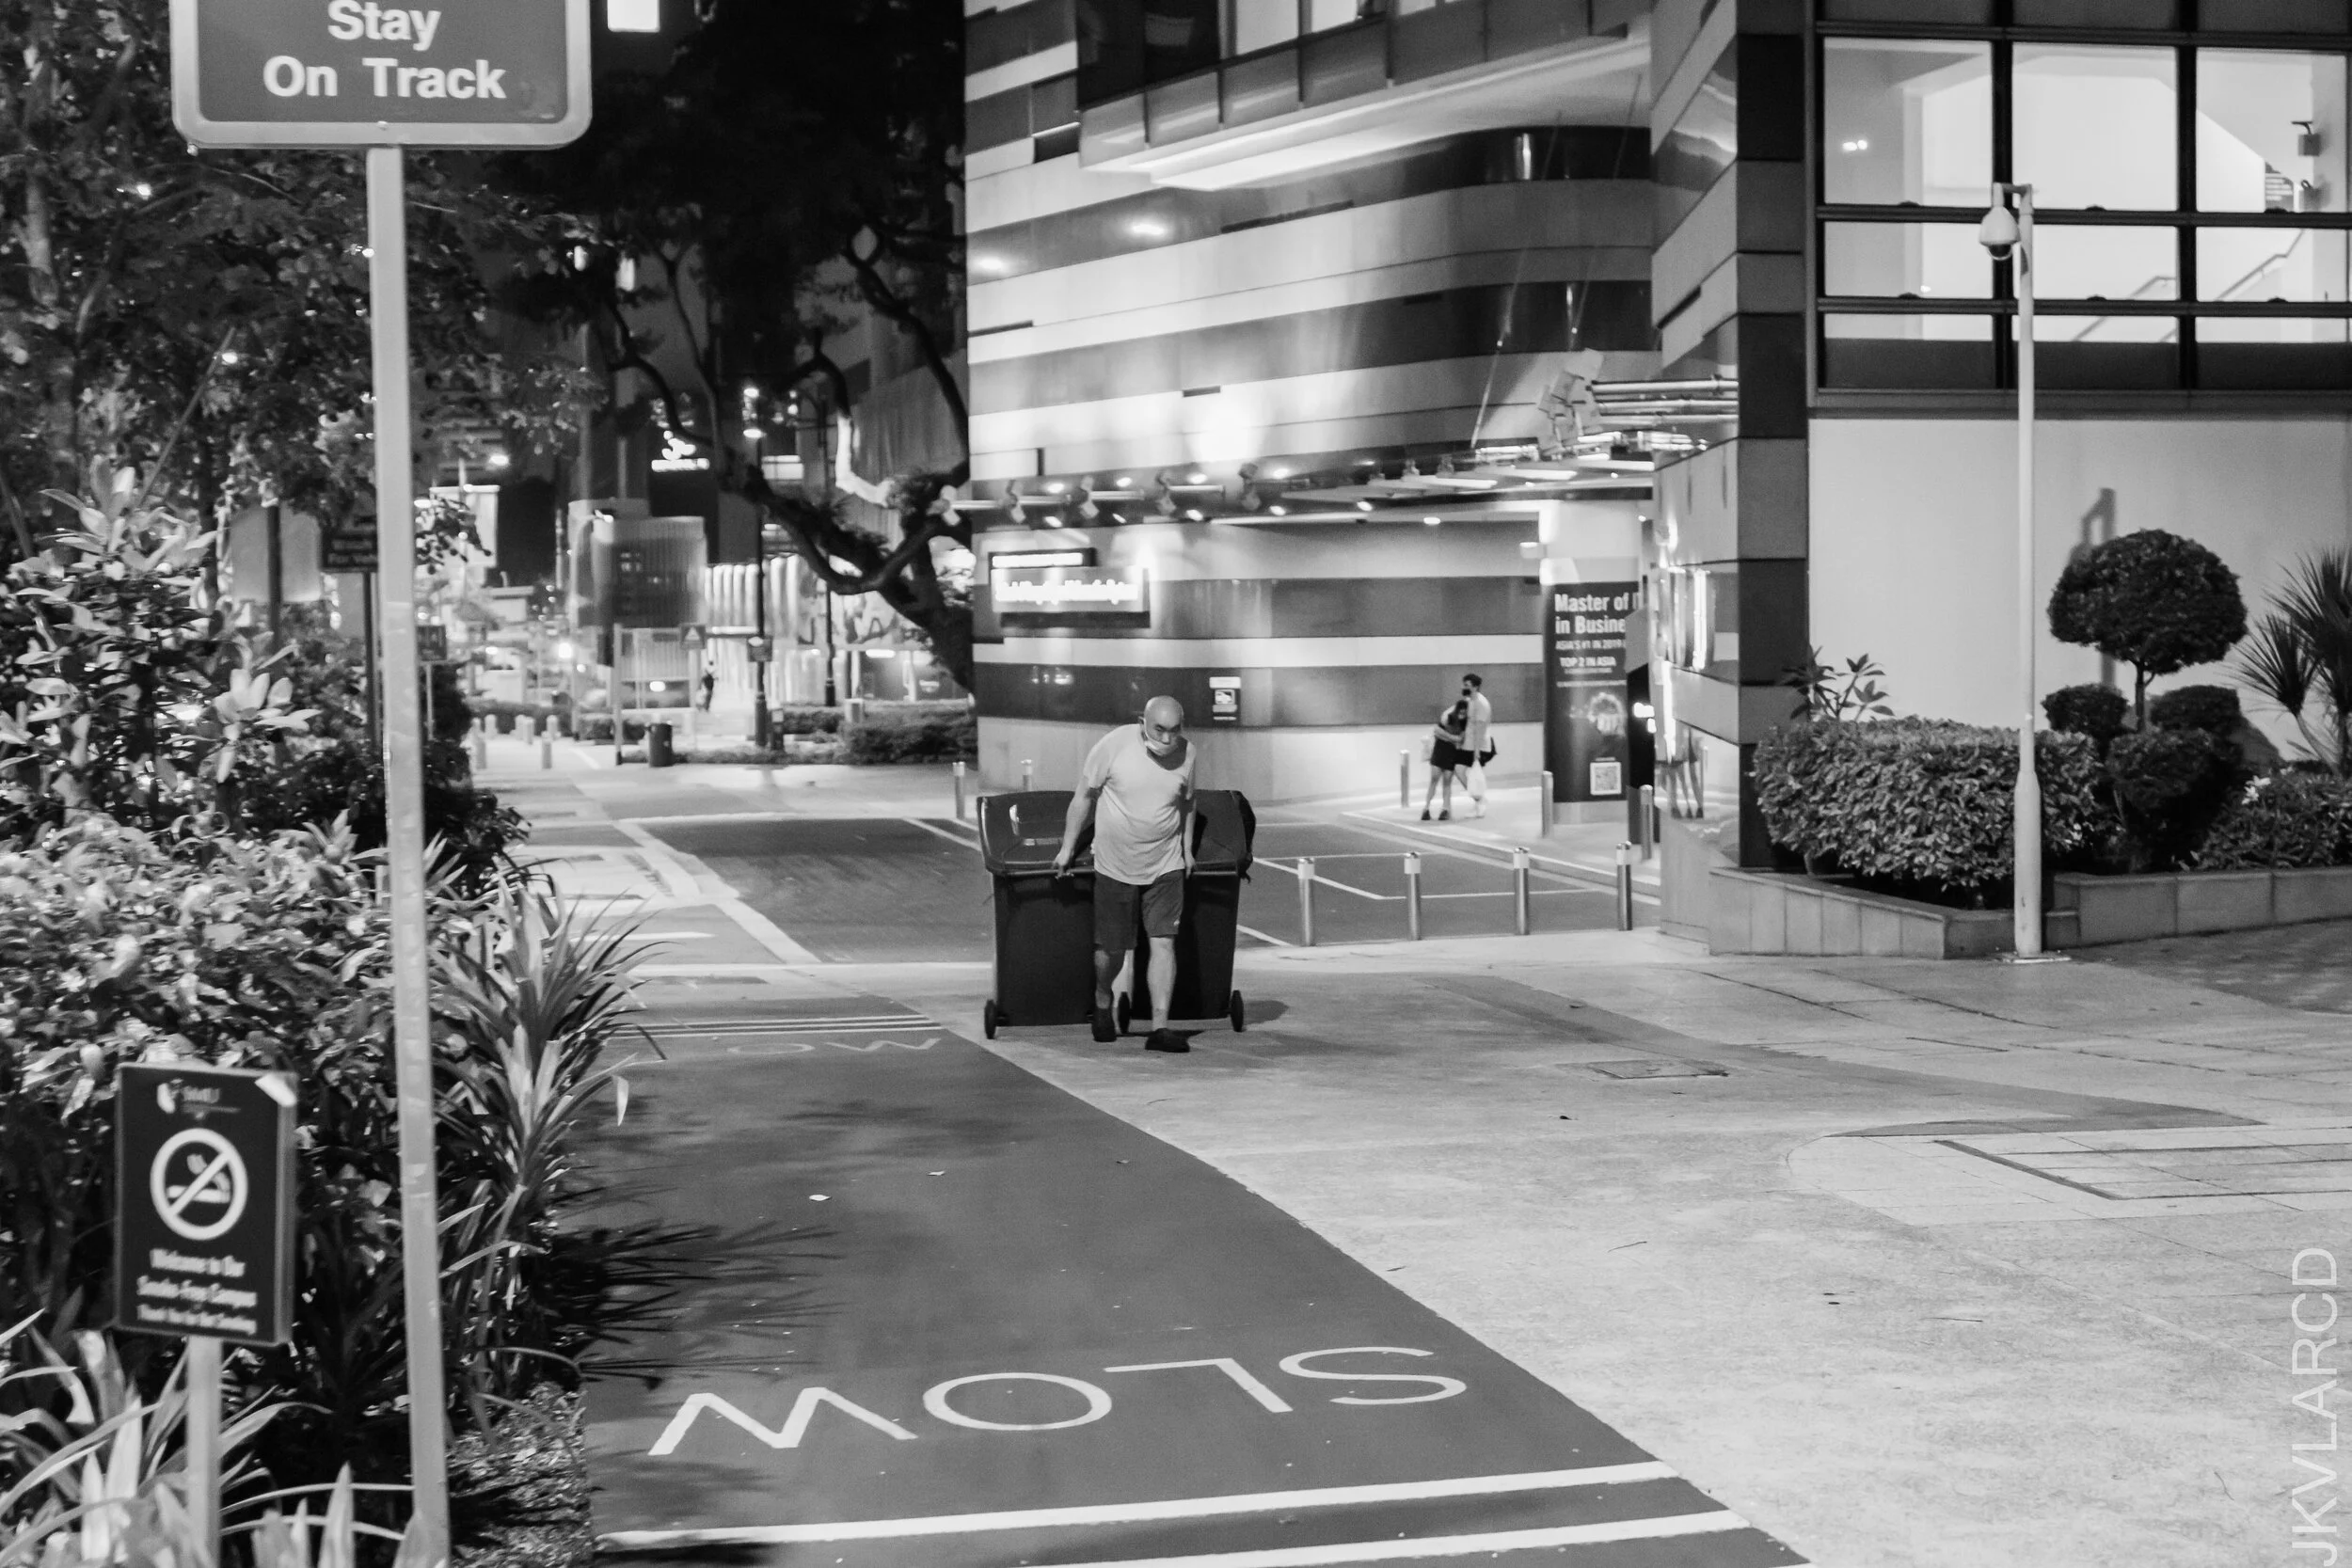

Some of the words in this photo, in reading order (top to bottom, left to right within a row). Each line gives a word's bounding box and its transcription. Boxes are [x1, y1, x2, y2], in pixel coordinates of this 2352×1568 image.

[327, 0, 441, 51] Stay
[263, 55, 338, 97] On
[362, 57, 507, 99] Track
[1554, 594, 1610, 612] Master
[1613, 593, 1629, 611] of
[1555, 616, 1570, 634] in
[646, 1346, 1468, 1457] SLOW
